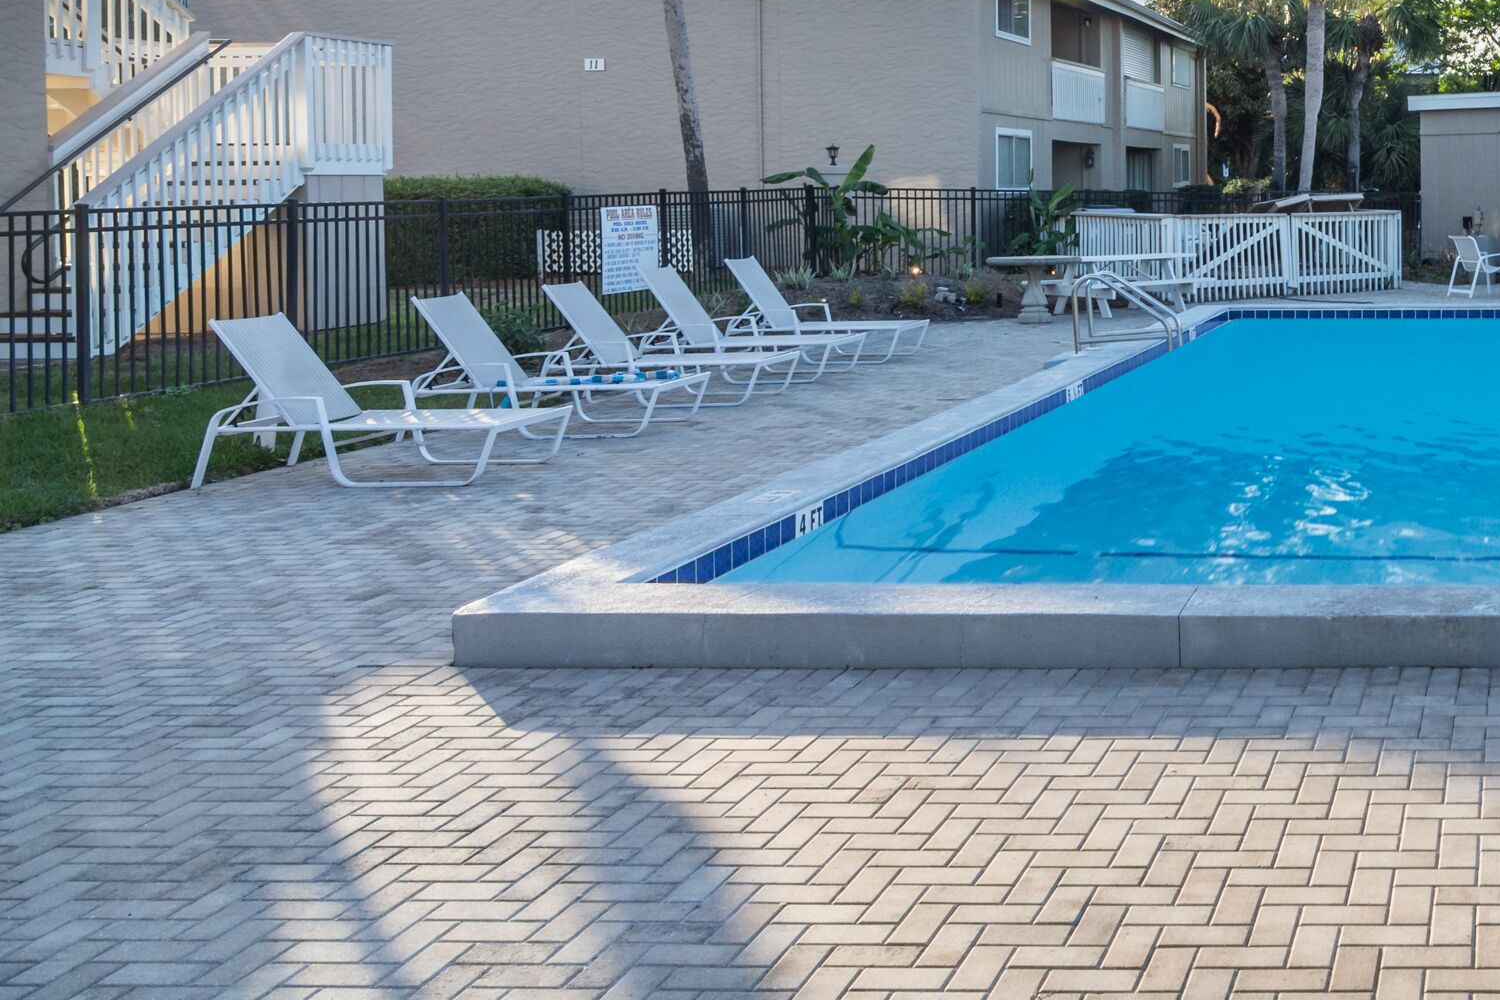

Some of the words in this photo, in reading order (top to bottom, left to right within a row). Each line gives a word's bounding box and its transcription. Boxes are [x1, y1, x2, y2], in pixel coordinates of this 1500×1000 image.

[606, 209, 619, 220] POOL
[621, 208, 635, 219] AREA
[636, 207, 652, 218] RULES
[627, 232, 644, 240] DIVING
[800, 513, 805, 536] 4
